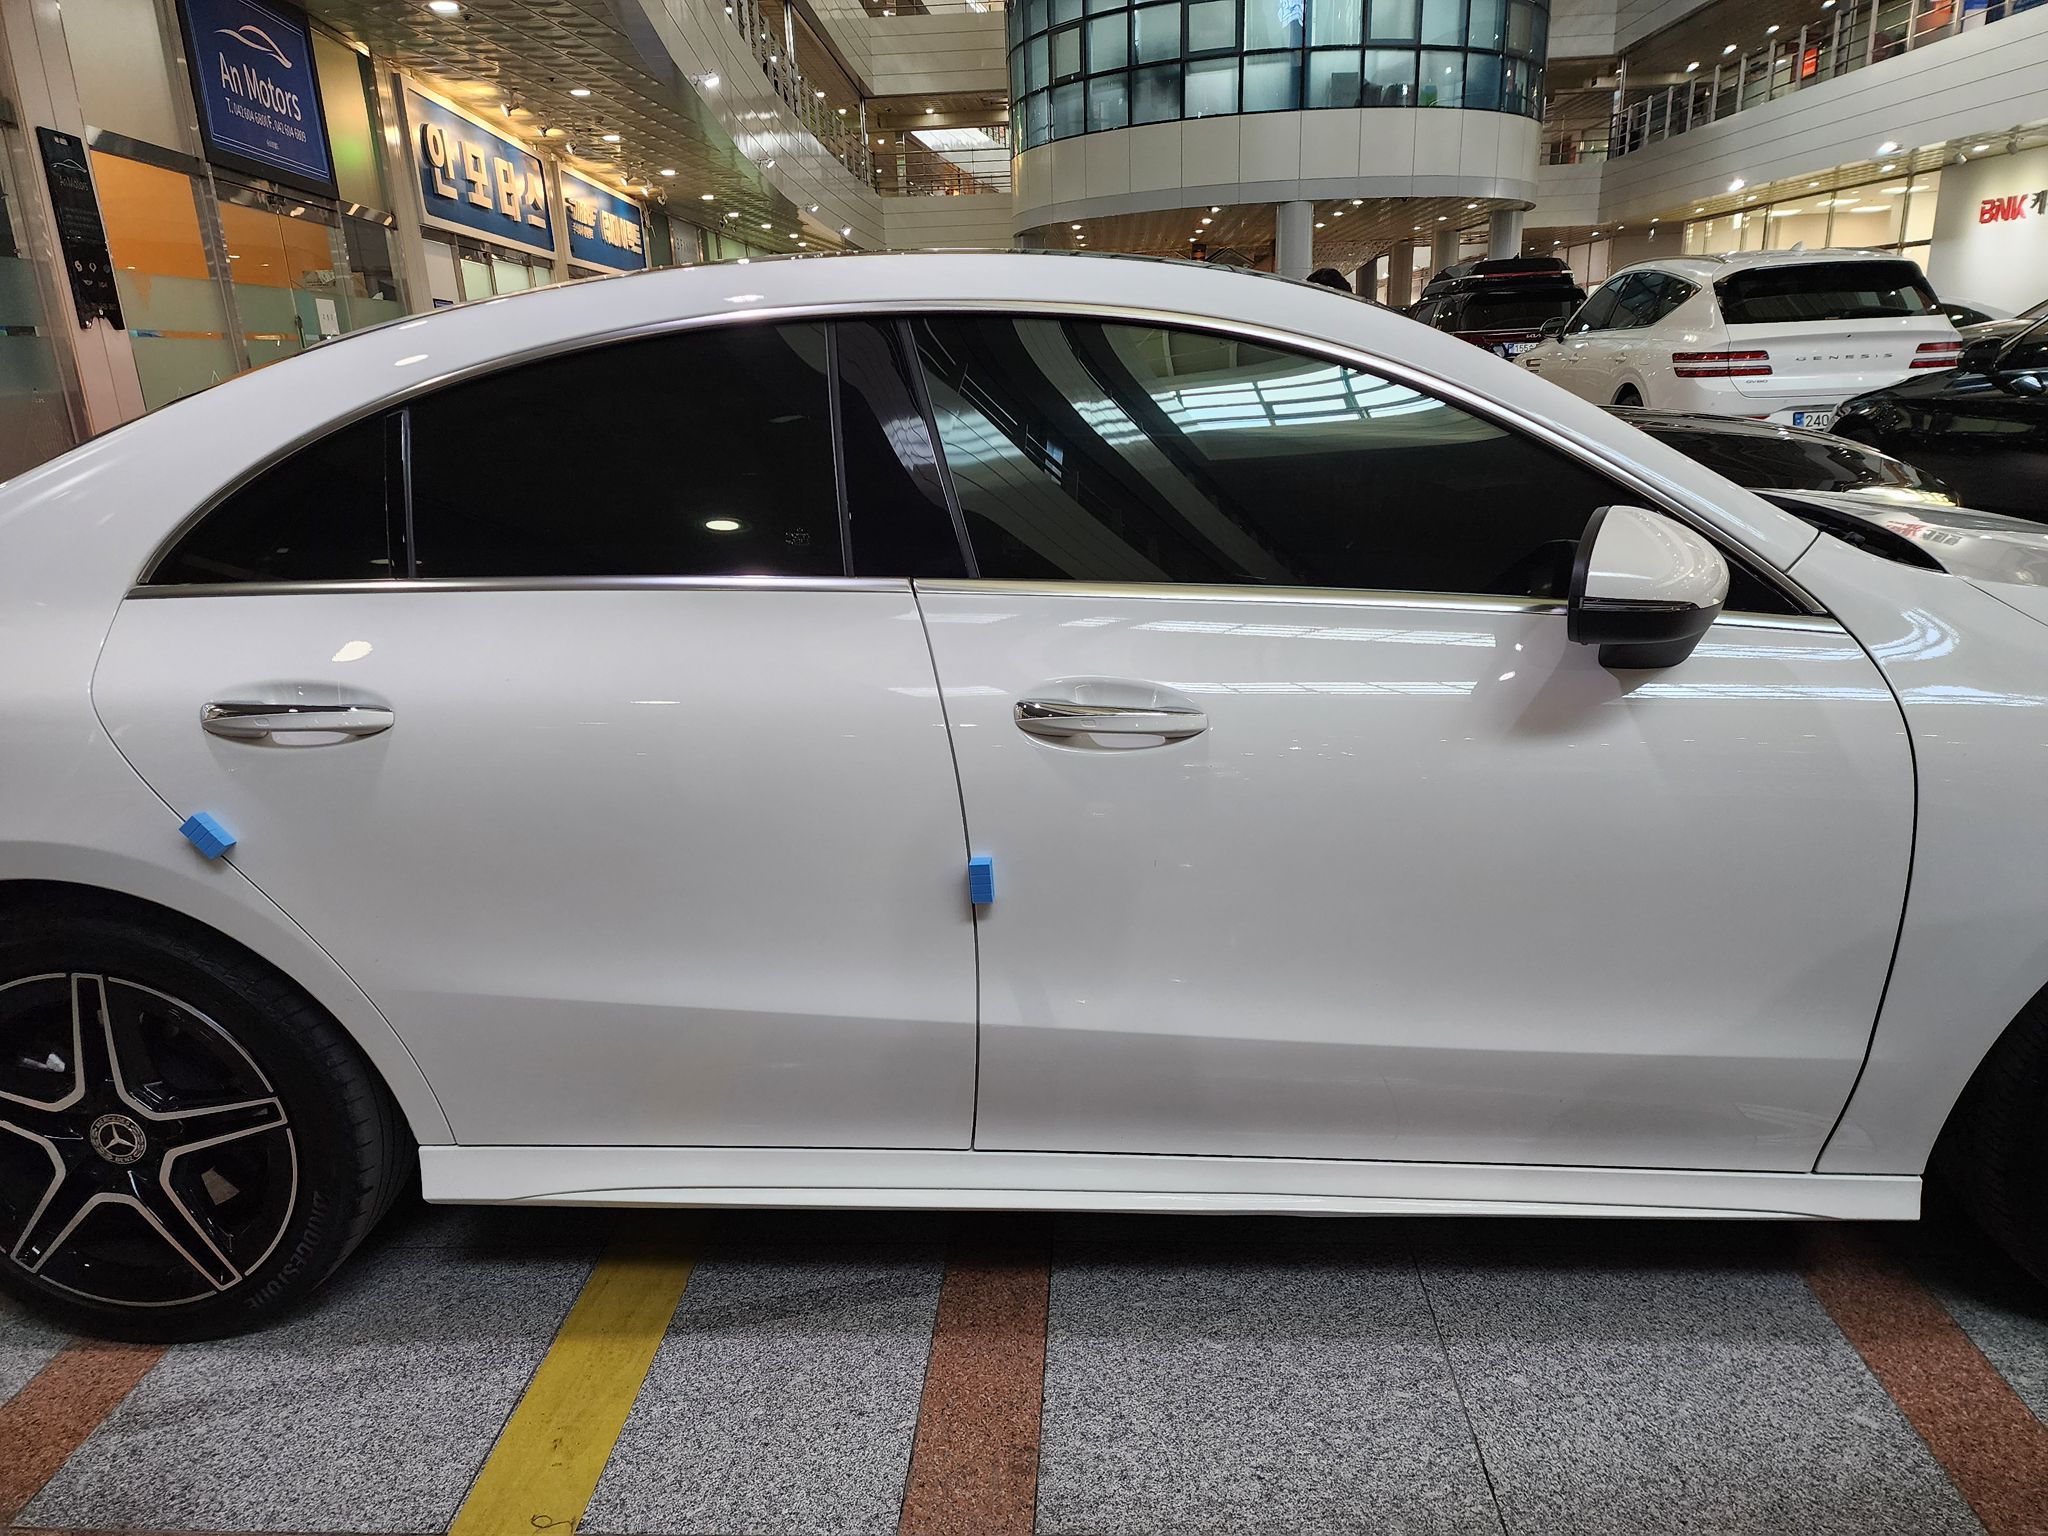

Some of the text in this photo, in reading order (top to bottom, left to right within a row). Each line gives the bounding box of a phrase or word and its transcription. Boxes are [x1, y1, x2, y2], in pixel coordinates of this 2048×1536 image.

[219, 52, 302, 121] An Motors
[1979, 193, 2029, 224] BNK
[1795, 352, 1893, 361] GENESIS
[1805, 414, 1830, 427] 240
